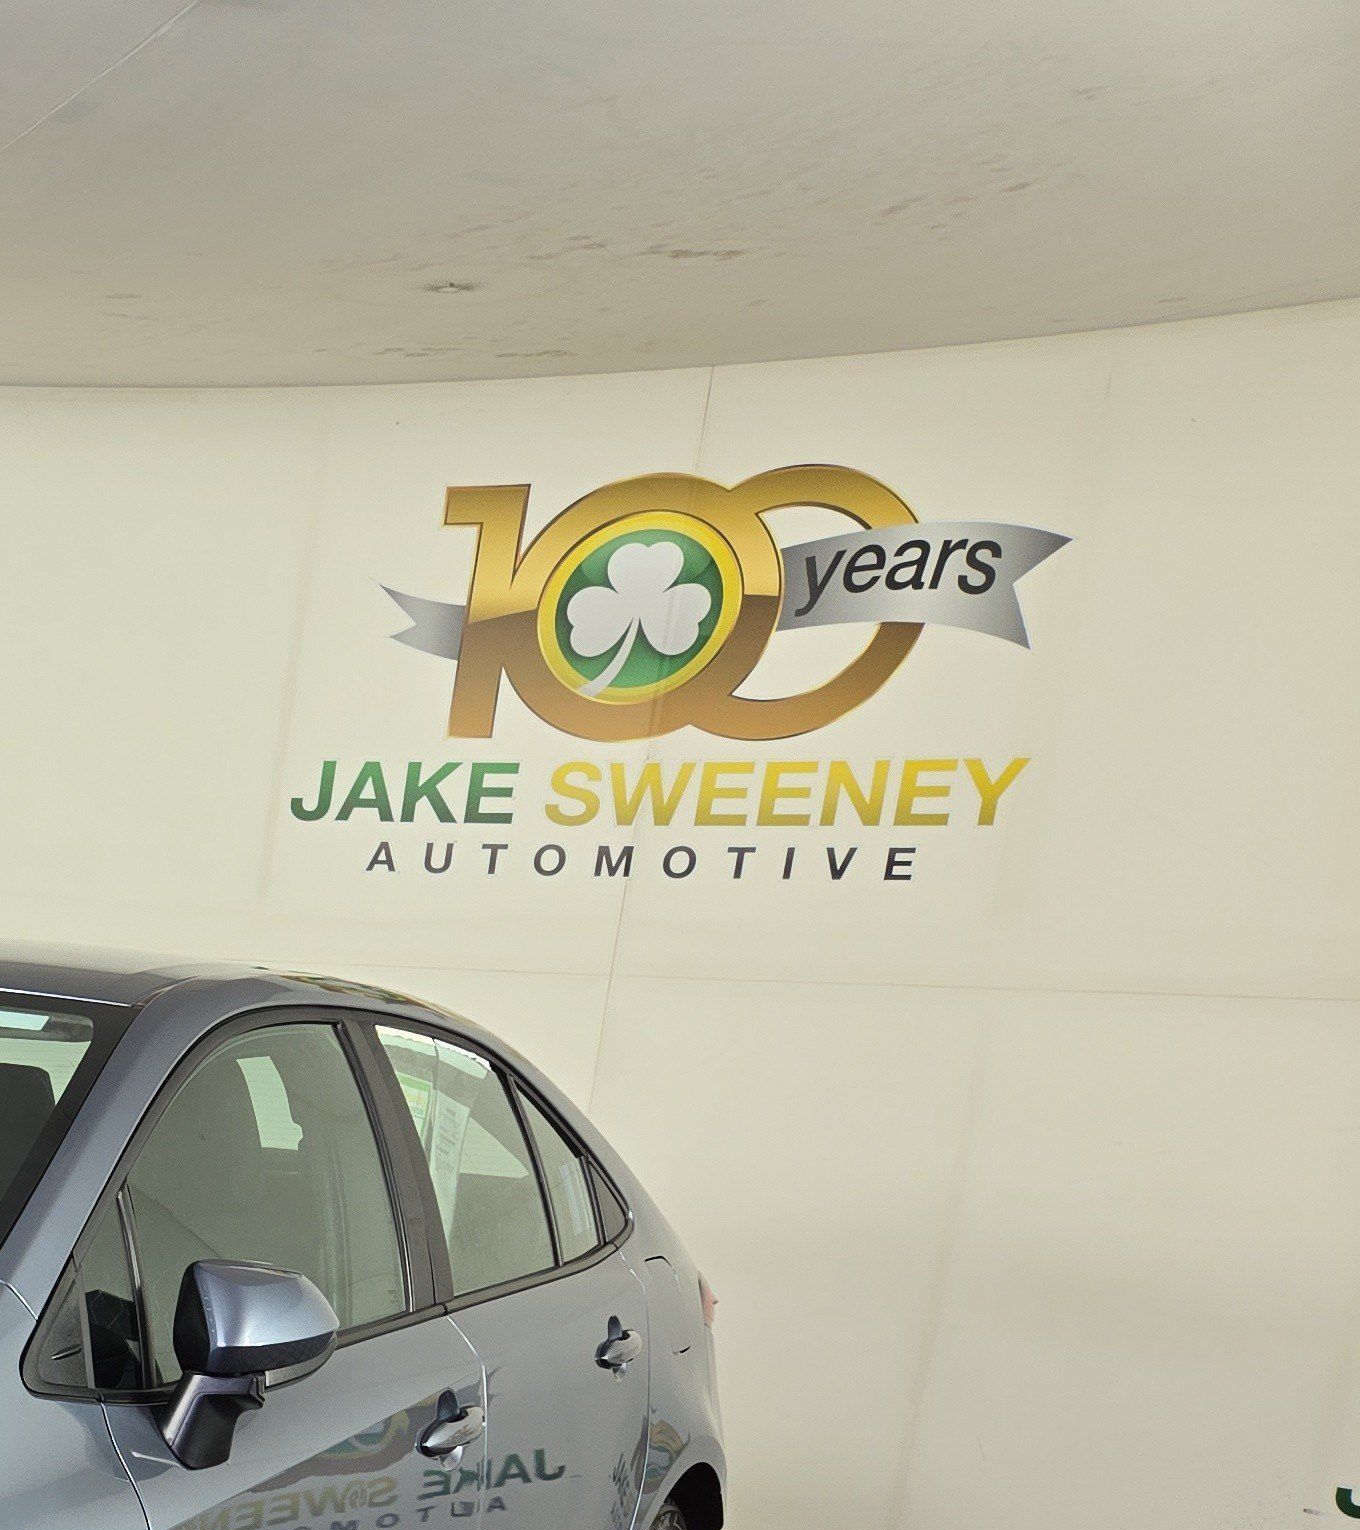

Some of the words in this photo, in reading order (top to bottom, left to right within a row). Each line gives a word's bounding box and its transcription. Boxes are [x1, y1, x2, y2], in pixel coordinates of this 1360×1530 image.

[442, 462, 925, 744] 100
[793, 530, 1003, 618] years
[289, 759, 521, 826] JAKE
[543, 756, 1031, 828] SWEENEY
[366, 840, 917, 882] AUTOMOTIVE
